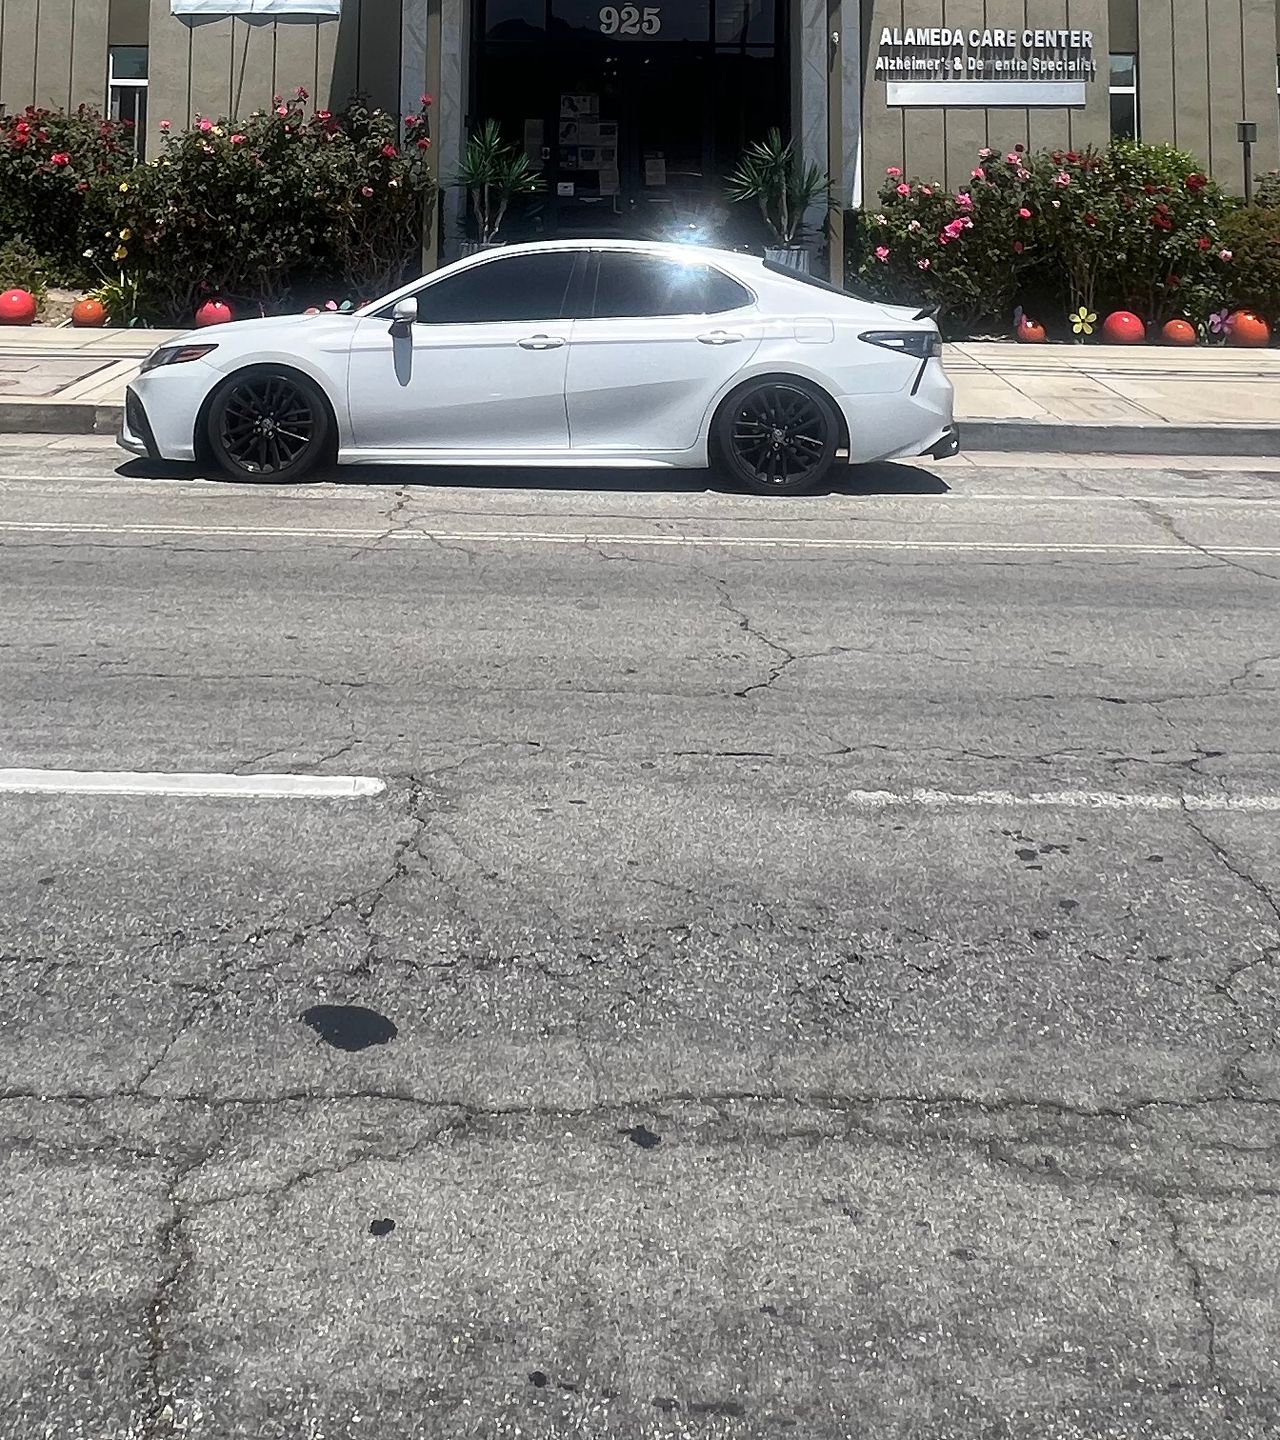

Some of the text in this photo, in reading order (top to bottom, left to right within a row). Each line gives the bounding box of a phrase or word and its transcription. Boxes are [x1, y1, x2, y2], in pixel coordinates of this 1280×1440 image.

[599, 6, 661, 35] 925
[880, 27, 1093, 48] ALAMEDA CARE CENTER
[875, 56, 952, 71] Alzheimer's
[954, 57, 964, 71] &
[1032, 57, 1097, 74] Specialist
